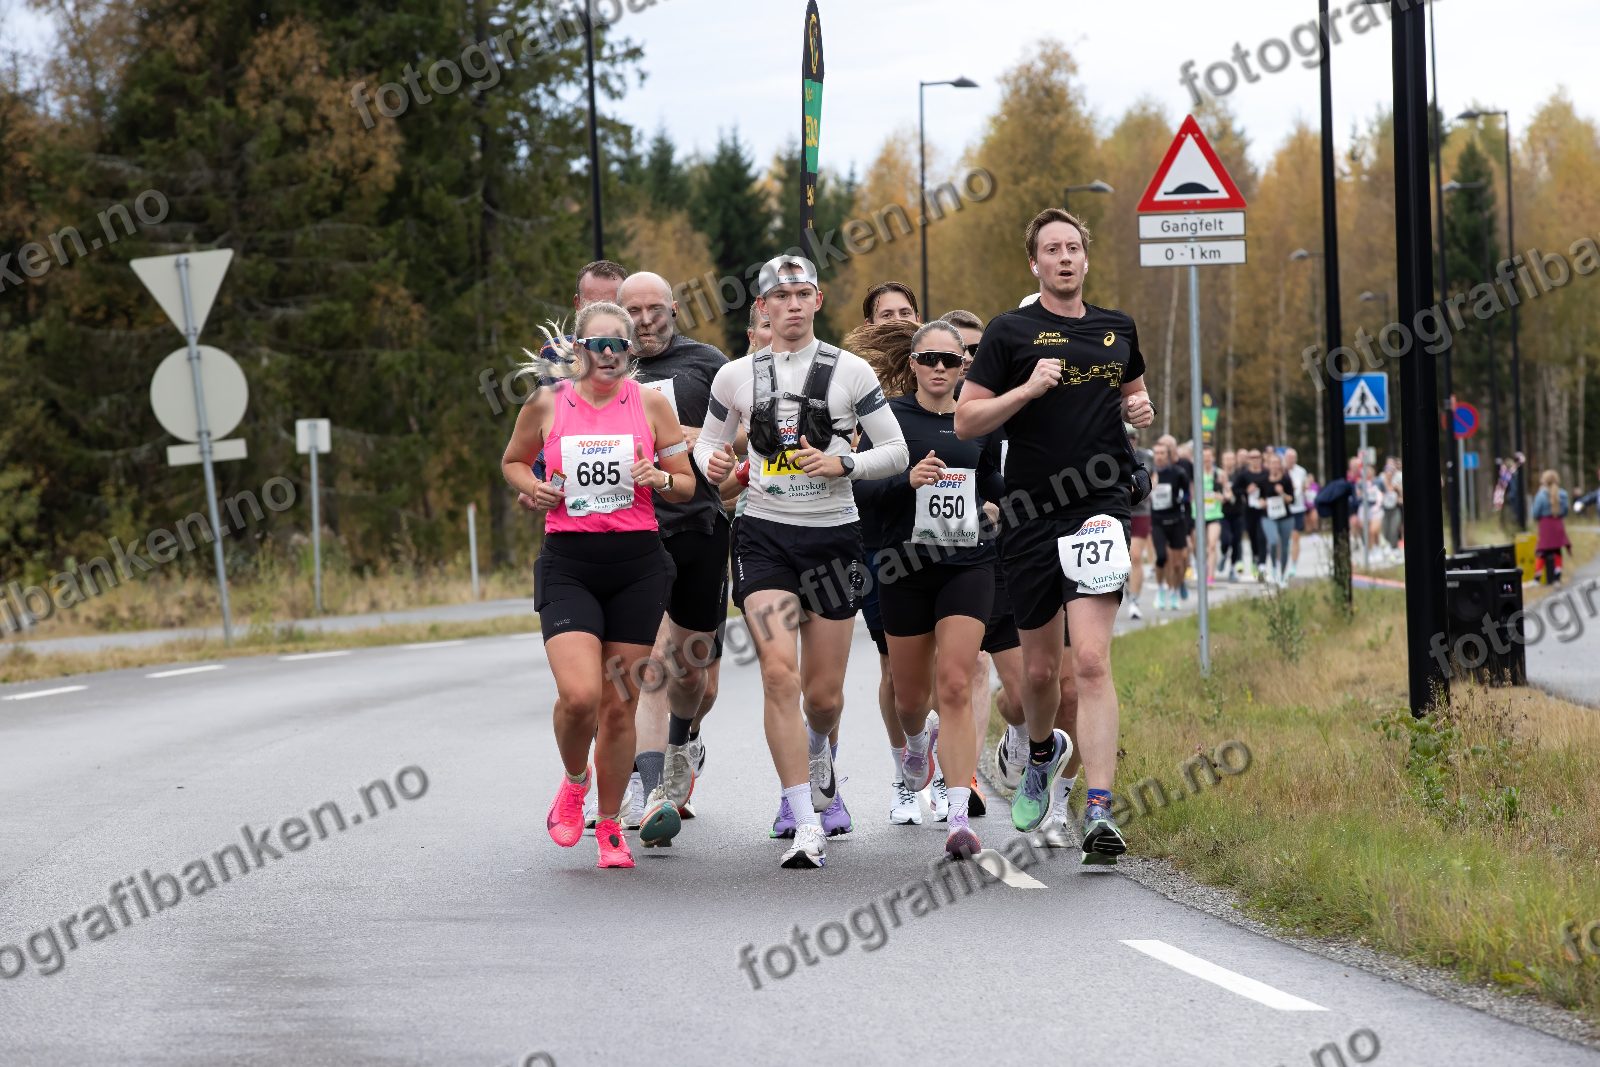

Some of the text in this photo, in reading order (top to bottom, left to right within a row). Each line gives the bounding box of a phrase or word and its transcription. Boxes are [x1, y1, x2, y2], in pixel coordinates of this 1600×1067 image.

[1161, 219, 1224, 235] Gangfelt
[1165, 248, 1174, 260] 0
[1190, 248, 1195, 260] 1
[1200, 247, 1221, 260] km
[577, 440, 621, 448] NORGES
[581, 447, 614, 455] LØPET
[577, 461, 620, 486] 685
[788, 481, 827, 492] Aurskog
[594, 493, 632, 505] Aurskog
[929, 494, 965, 519] 650
[940, 529, 976, 539] Aurskog
[1071, 539, 1114, 567] 737
